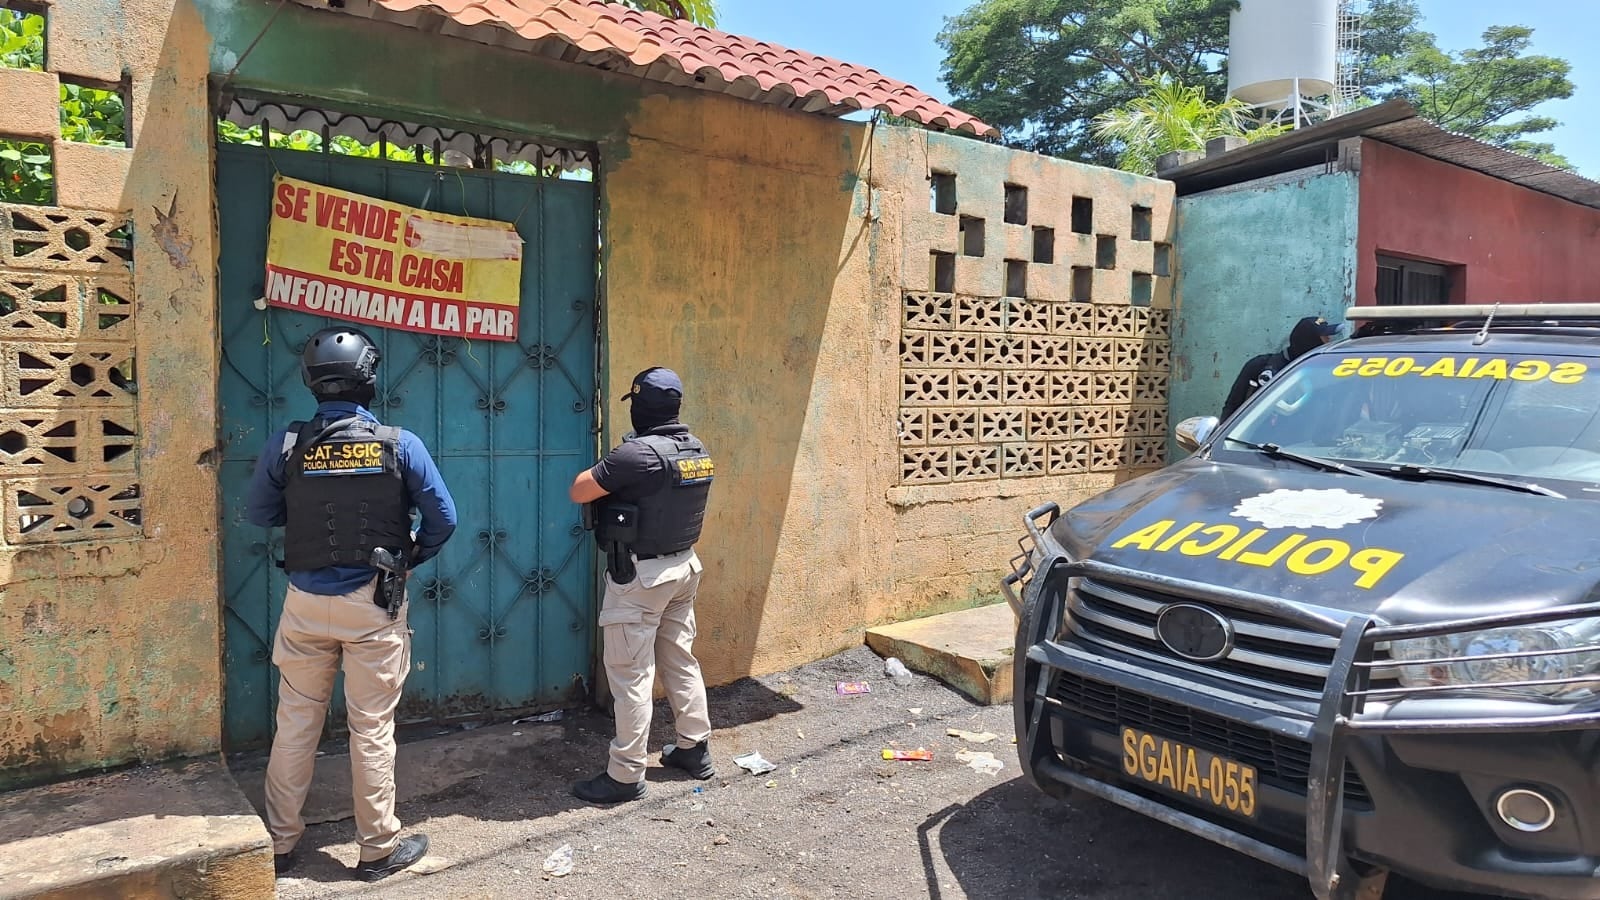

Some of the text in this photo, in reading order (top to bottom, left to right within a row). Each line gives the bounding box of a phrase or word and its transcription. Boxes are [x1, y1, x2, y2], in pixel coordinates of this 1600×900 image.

[275, 183, 311, 223] SE
[315, 191, 402, 245] VENDE
[329, 238, 464, 293] ESTA CASA
[266, 270, 515, 337] INFORMAN A LA PAR
[303, 458, 383, 470] POLICIA NACIONAL CIVIL
[1122, 728, 1256, 817] SGAIA-055
